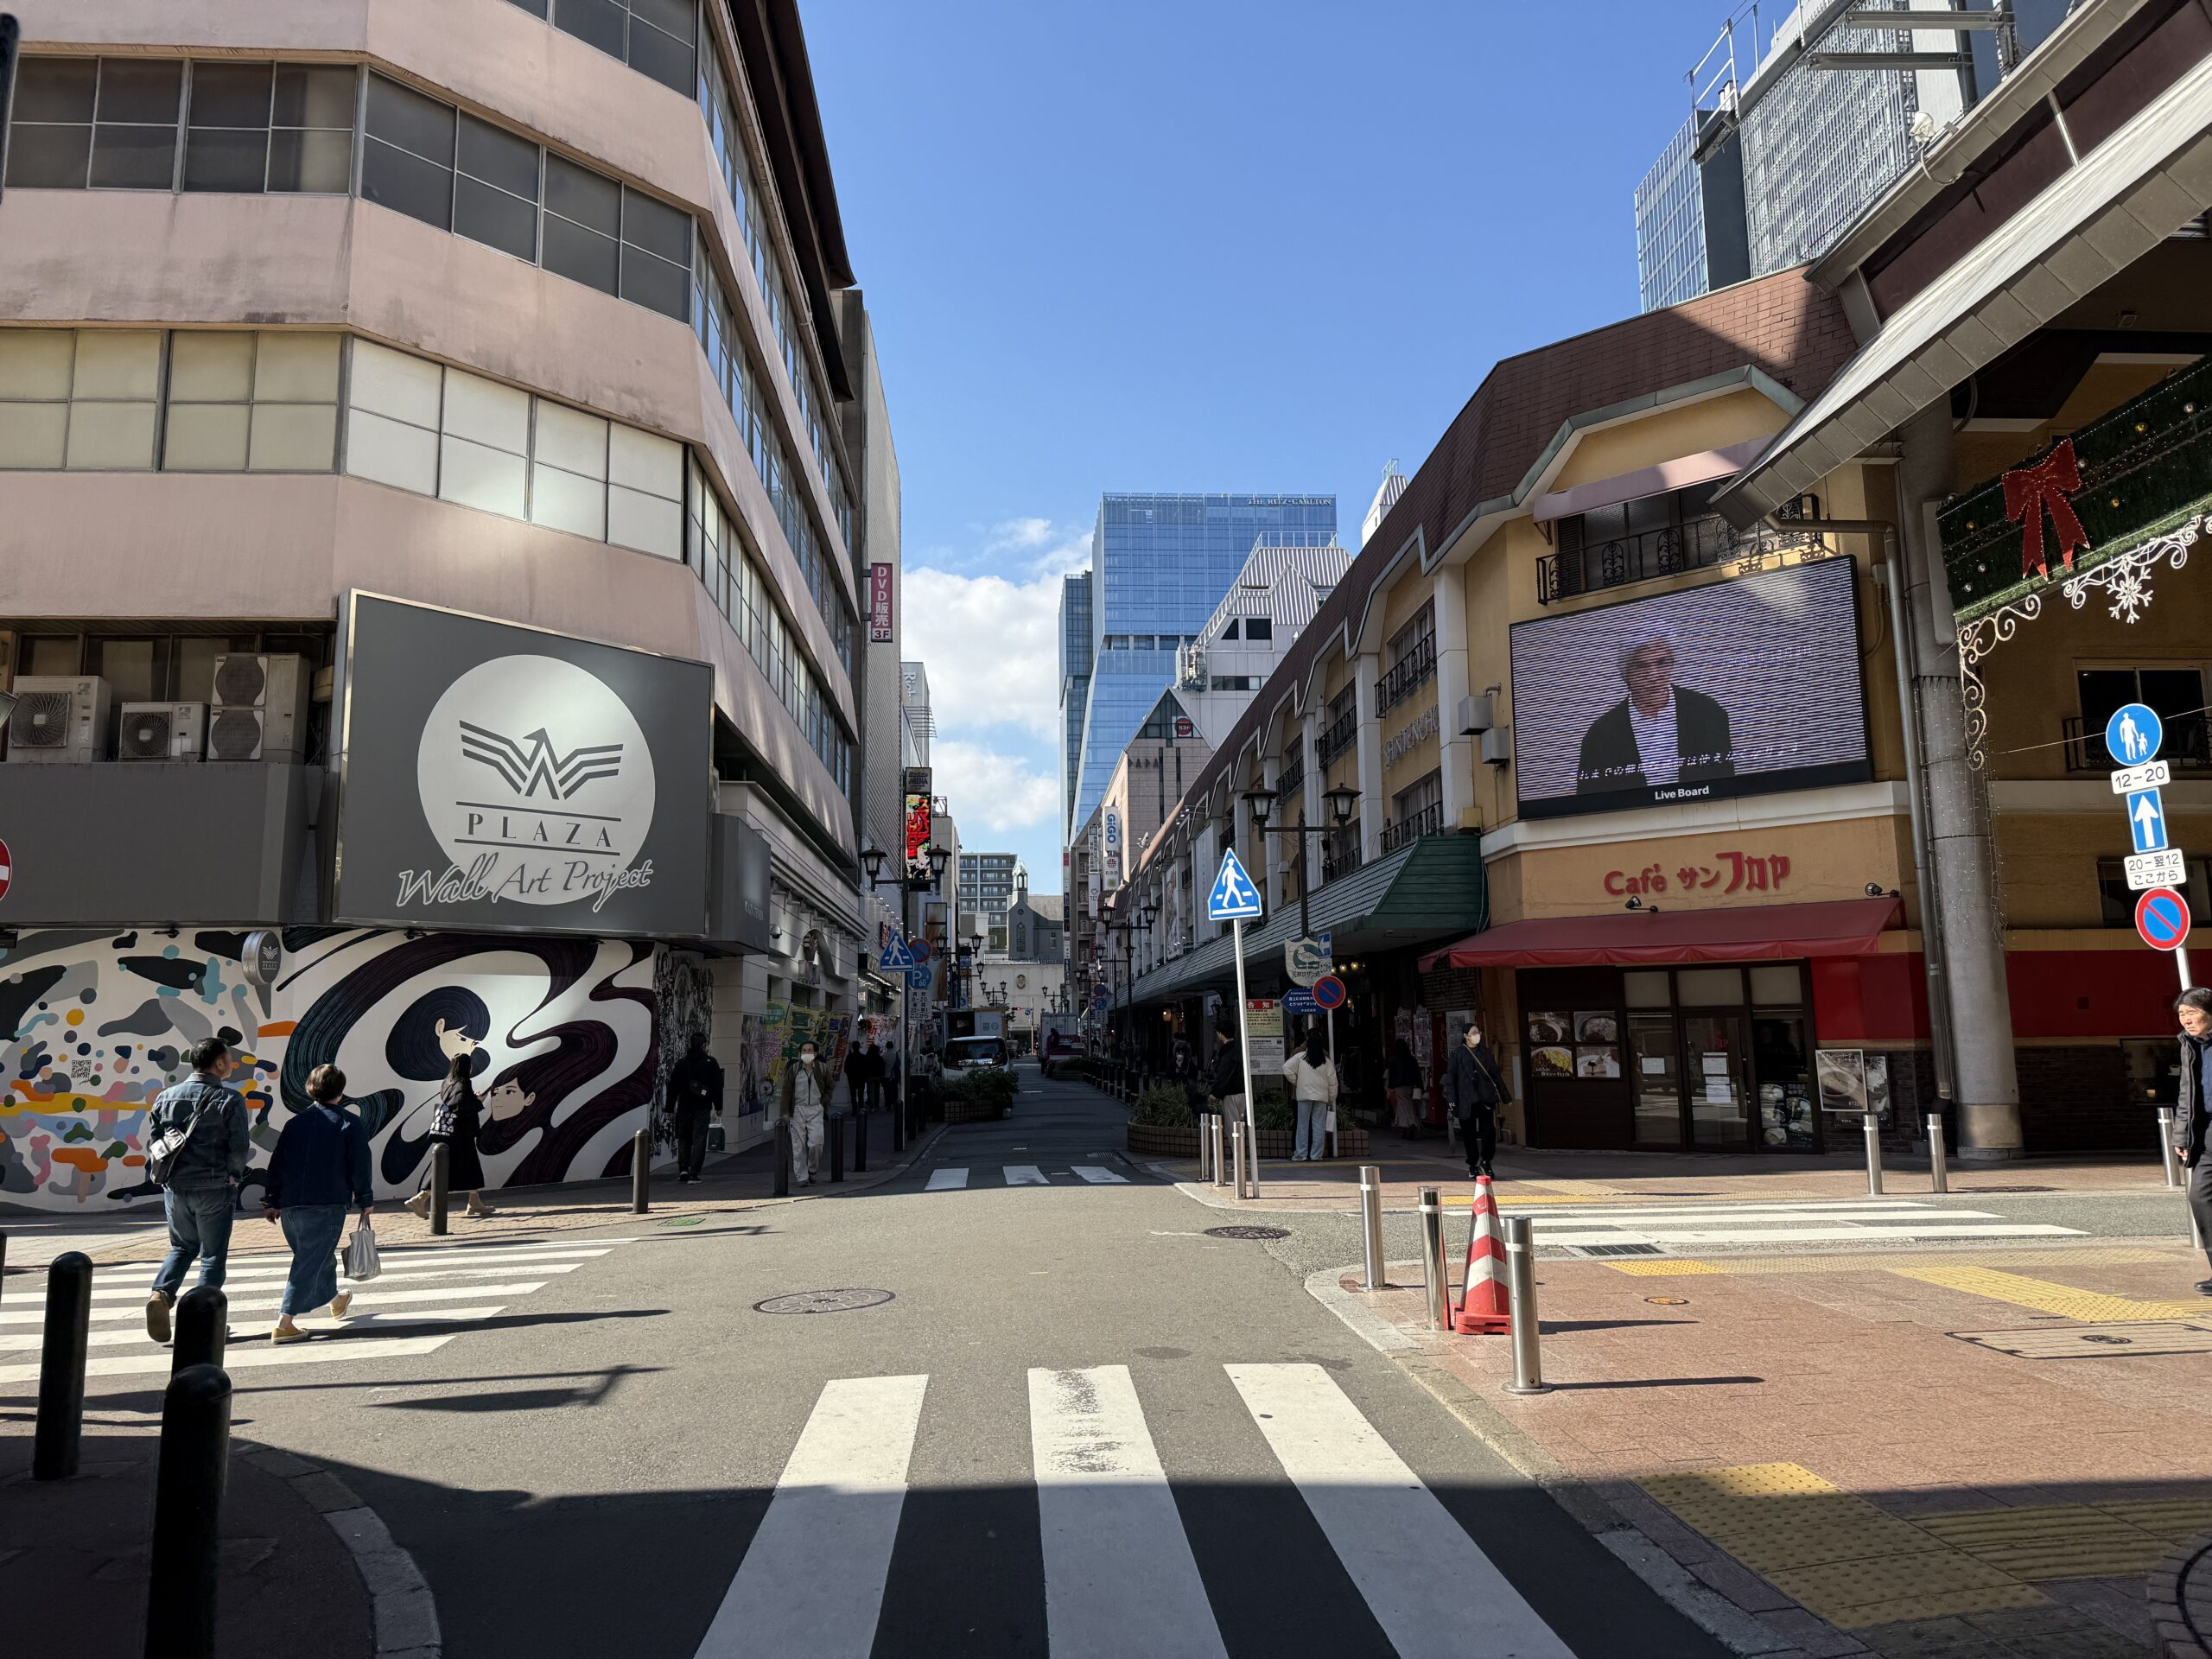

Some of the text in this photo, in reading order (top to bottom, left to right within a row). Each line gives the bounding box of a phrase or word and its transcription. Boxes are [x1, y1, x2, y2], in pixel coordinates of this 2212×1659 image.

[1268, 498, 1332, 506] RITZ-CARLTON
[874, 566, 889, 626] DVD販売
[874, 630, 889, 639] 3F
[2114, 766, 2166, 789] 12-20
[1655, 785, 1710, 800] Live Board
[467, 812, 613, 849] PLAZA
[1107, 813, 1116, 843] GiGO
[2128, 853, 2180, 872] 20-翌12
[396, 851, 654, 914] Wall Art Project
[1603, 861, 1669, 897] Café
[2133, 870, 2179, 887] ここから
[912, 970, 923, 987] P
[918, 978, 926, 987] 60
